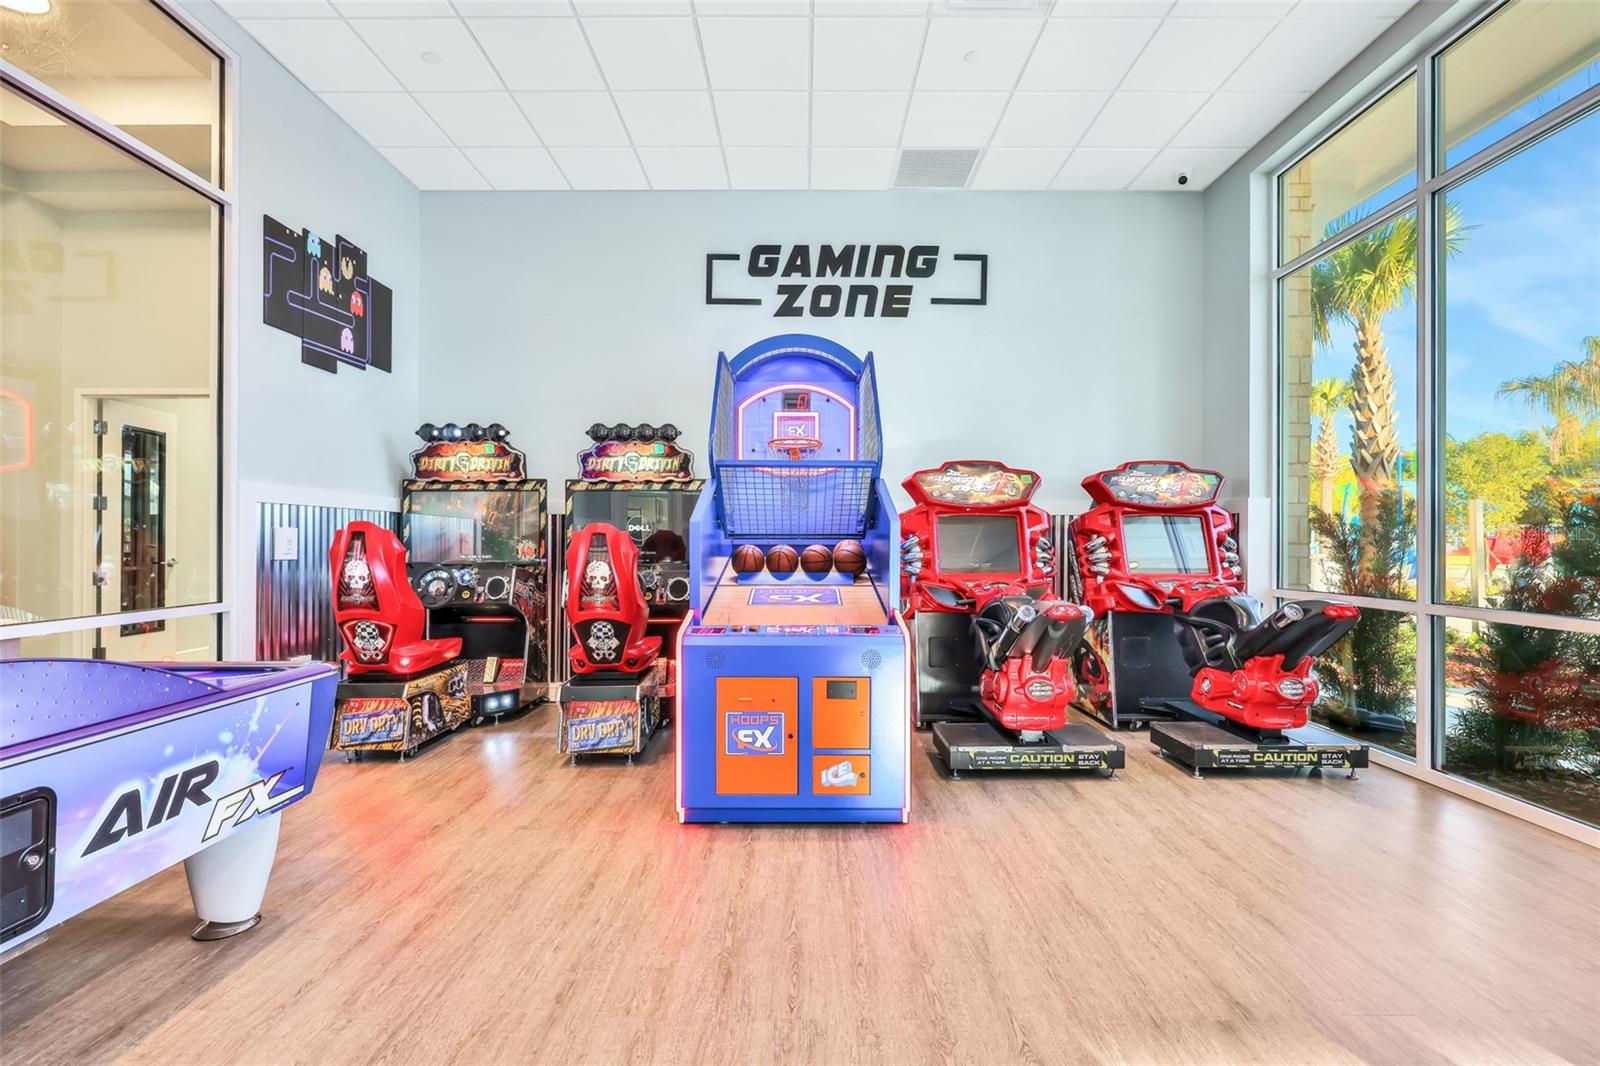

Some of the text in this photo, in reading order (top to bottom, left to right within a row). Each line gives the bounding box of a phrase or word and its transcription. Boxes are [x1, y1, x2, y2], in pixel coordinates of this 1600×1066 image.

[747, 244, 940, 278] GAMING
[773, 284, 914, 318] ZONE
[419, 456, 456, 473] DIRTY
[587, 456, 625, 473] DIRTY
[628, 524, 651, 532] DELL
[343, 714, 400, 736] DRV DRTY
[730, 715, 779, 725] HOOPS
[572, 719, 629, 742] DRV DRTY
[1010, 754, 1075, 763] CAUTION
[1253, 753, 1318, 762] CAUTION
[80, 759, 220, 859] AIR
[201, 766, 305, 844] FX
